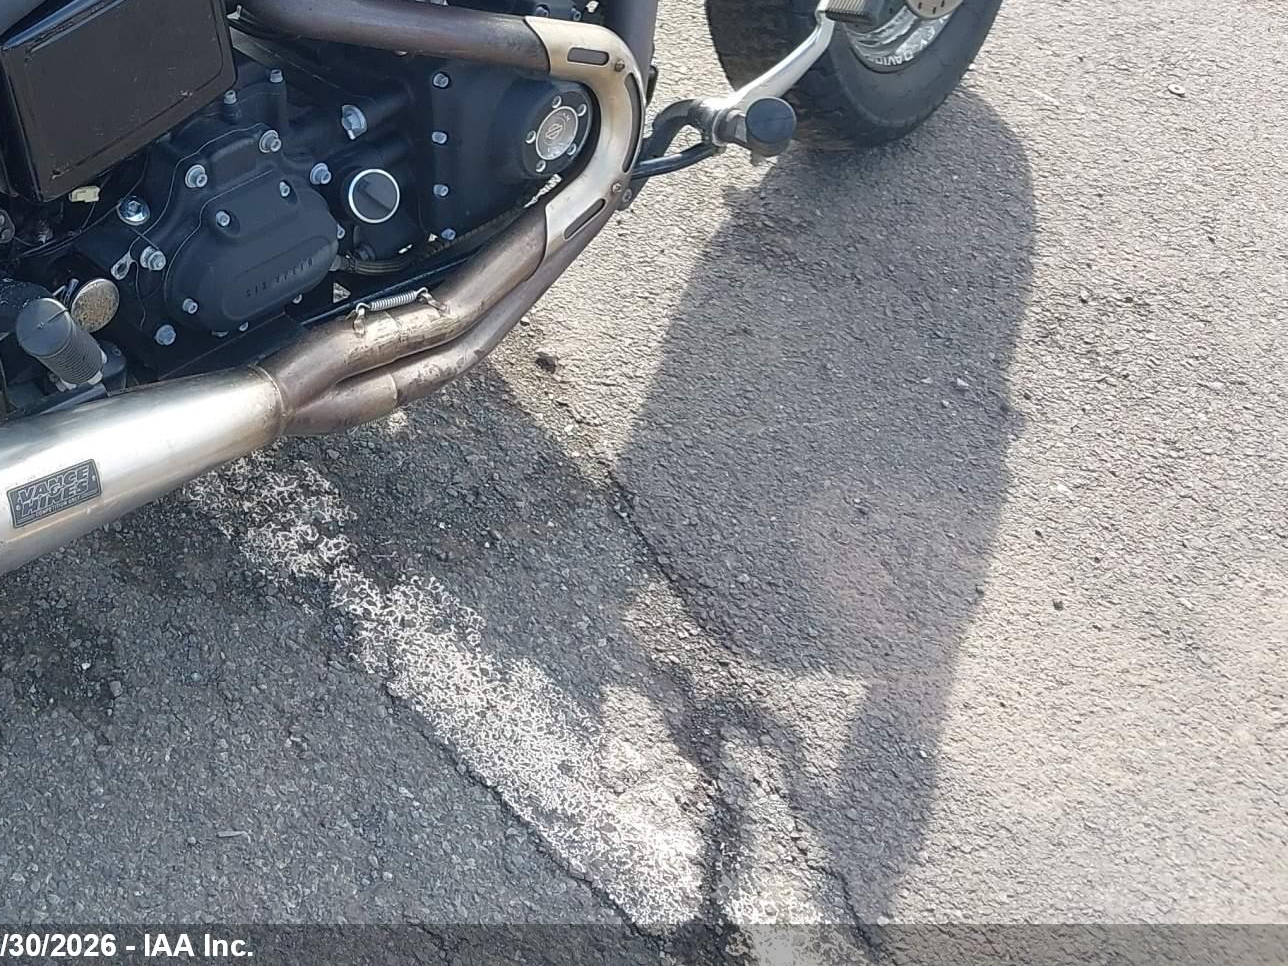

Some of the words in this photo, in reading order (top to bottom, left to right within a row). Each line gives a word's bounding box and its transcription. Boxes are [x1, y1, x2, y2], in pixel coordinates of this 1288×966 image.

[17, 464, 90, 503] VANCE
[21, 479, 90, 517] HINES
[35, 500, 68, 517] COMPETITION
